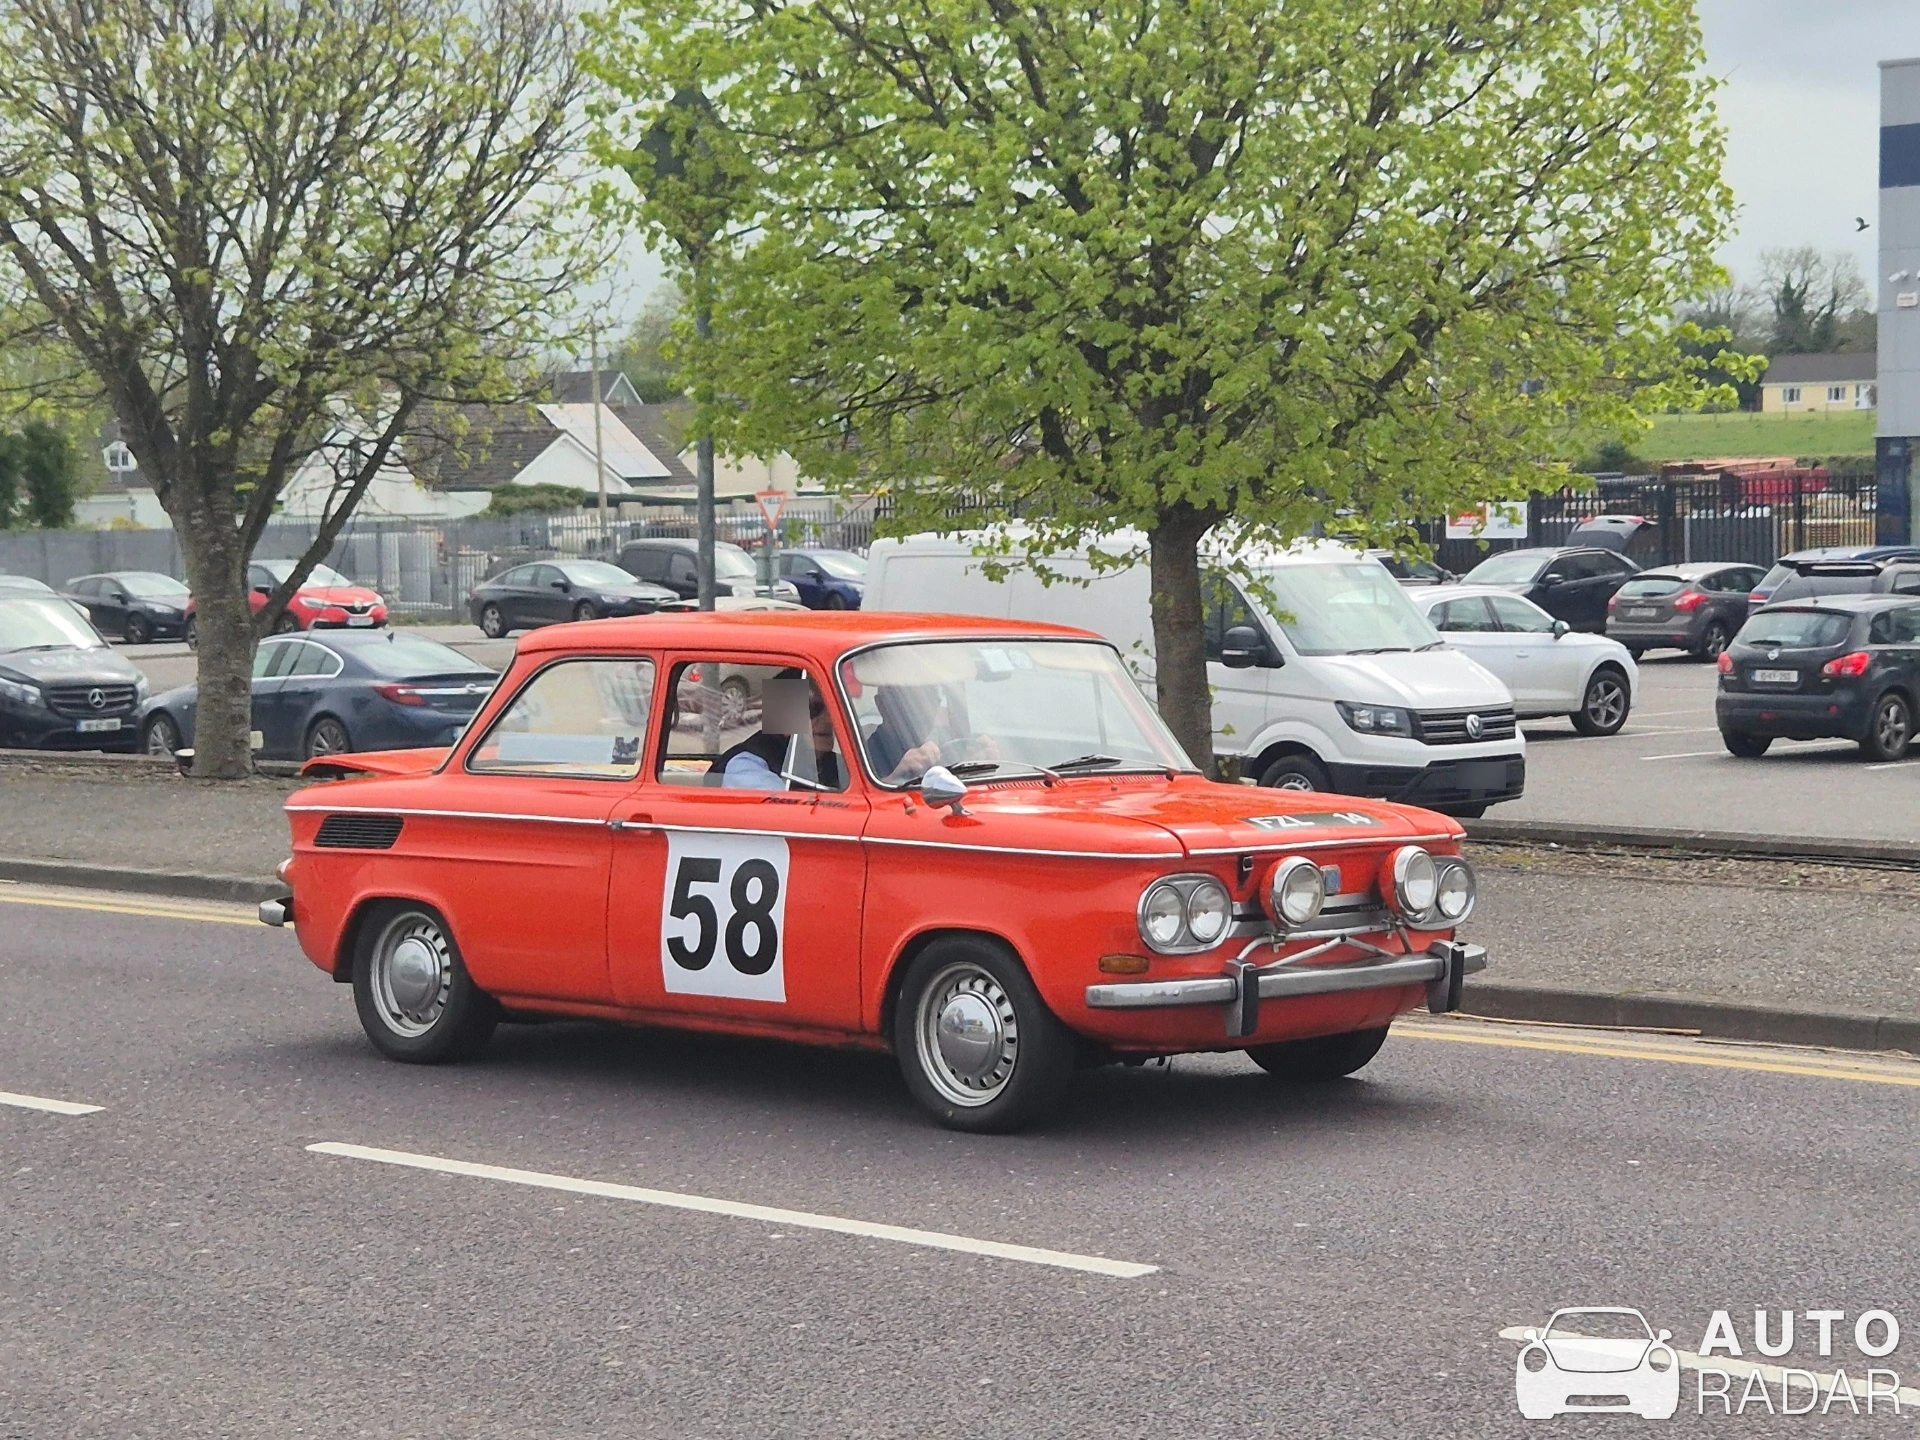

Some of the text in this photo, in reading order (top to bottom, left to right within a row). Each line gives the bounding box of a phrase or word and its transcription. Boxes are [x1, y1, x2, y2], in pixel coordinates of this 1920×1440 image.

[1248, 812, 1372, 829] FZL 14
[667, 856, 779, 975] 58
